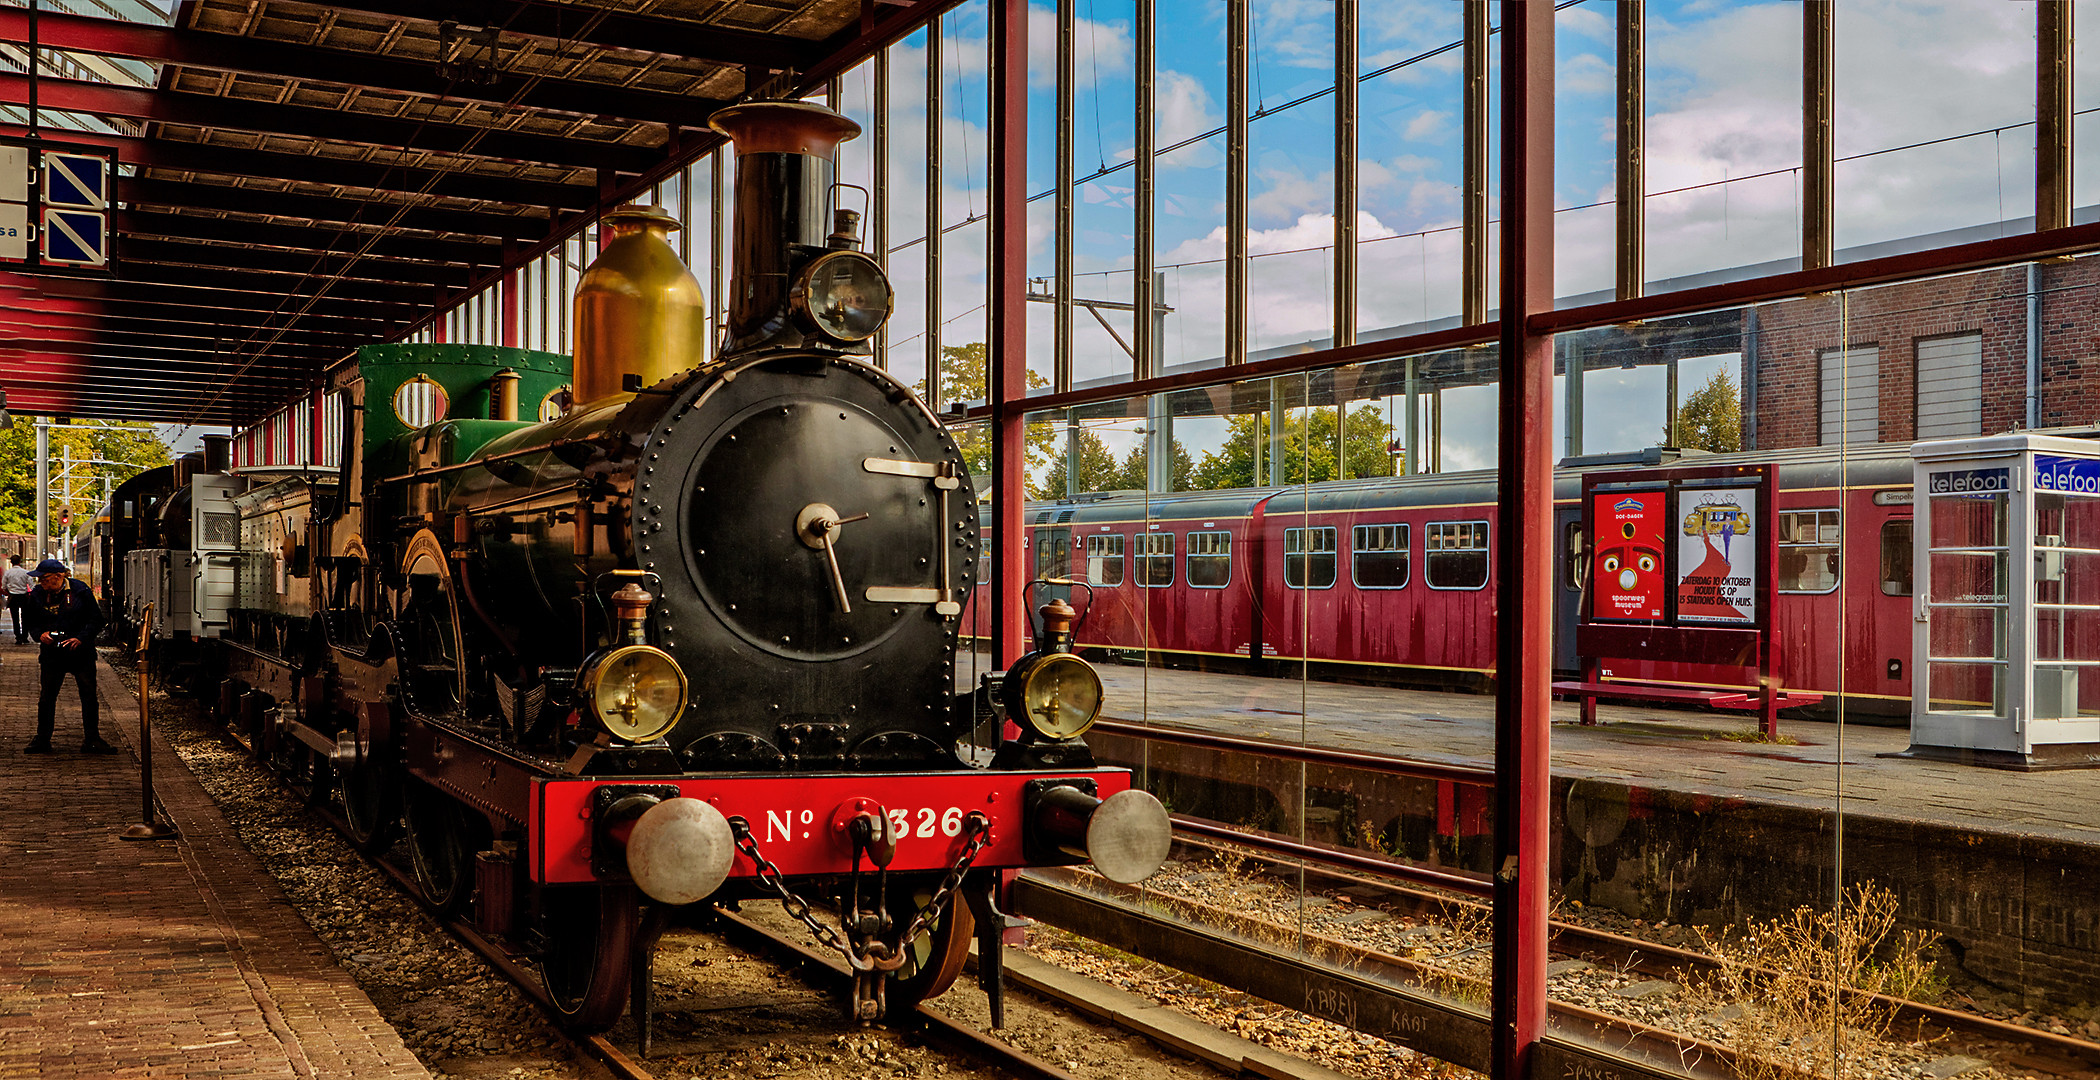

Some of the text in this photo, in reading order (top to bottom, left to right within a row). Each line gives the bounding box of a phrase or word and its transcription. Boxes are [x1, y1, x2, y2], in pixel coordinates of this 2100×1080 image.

[1931, 471, 2009, 492] telefoon
[2034, 464, 2100, 493] telefoo
[1076, 536, 1081, 547] 2
[1681, 576, 1752, 586] ZATERDAG 10 OKTOBER
[1694, 586, 1715, 595] HOUDT
[1727, 587, 1737, 596] OP
[1612, 595, 1645, 604] spoorweg
[1687, 595, 1715, 605] STATIONS
[1716, 597, 1734, 605] OPEN
[1735, 598, 1753, 607] HUIS.
[888, 807, 963, 839] 326
